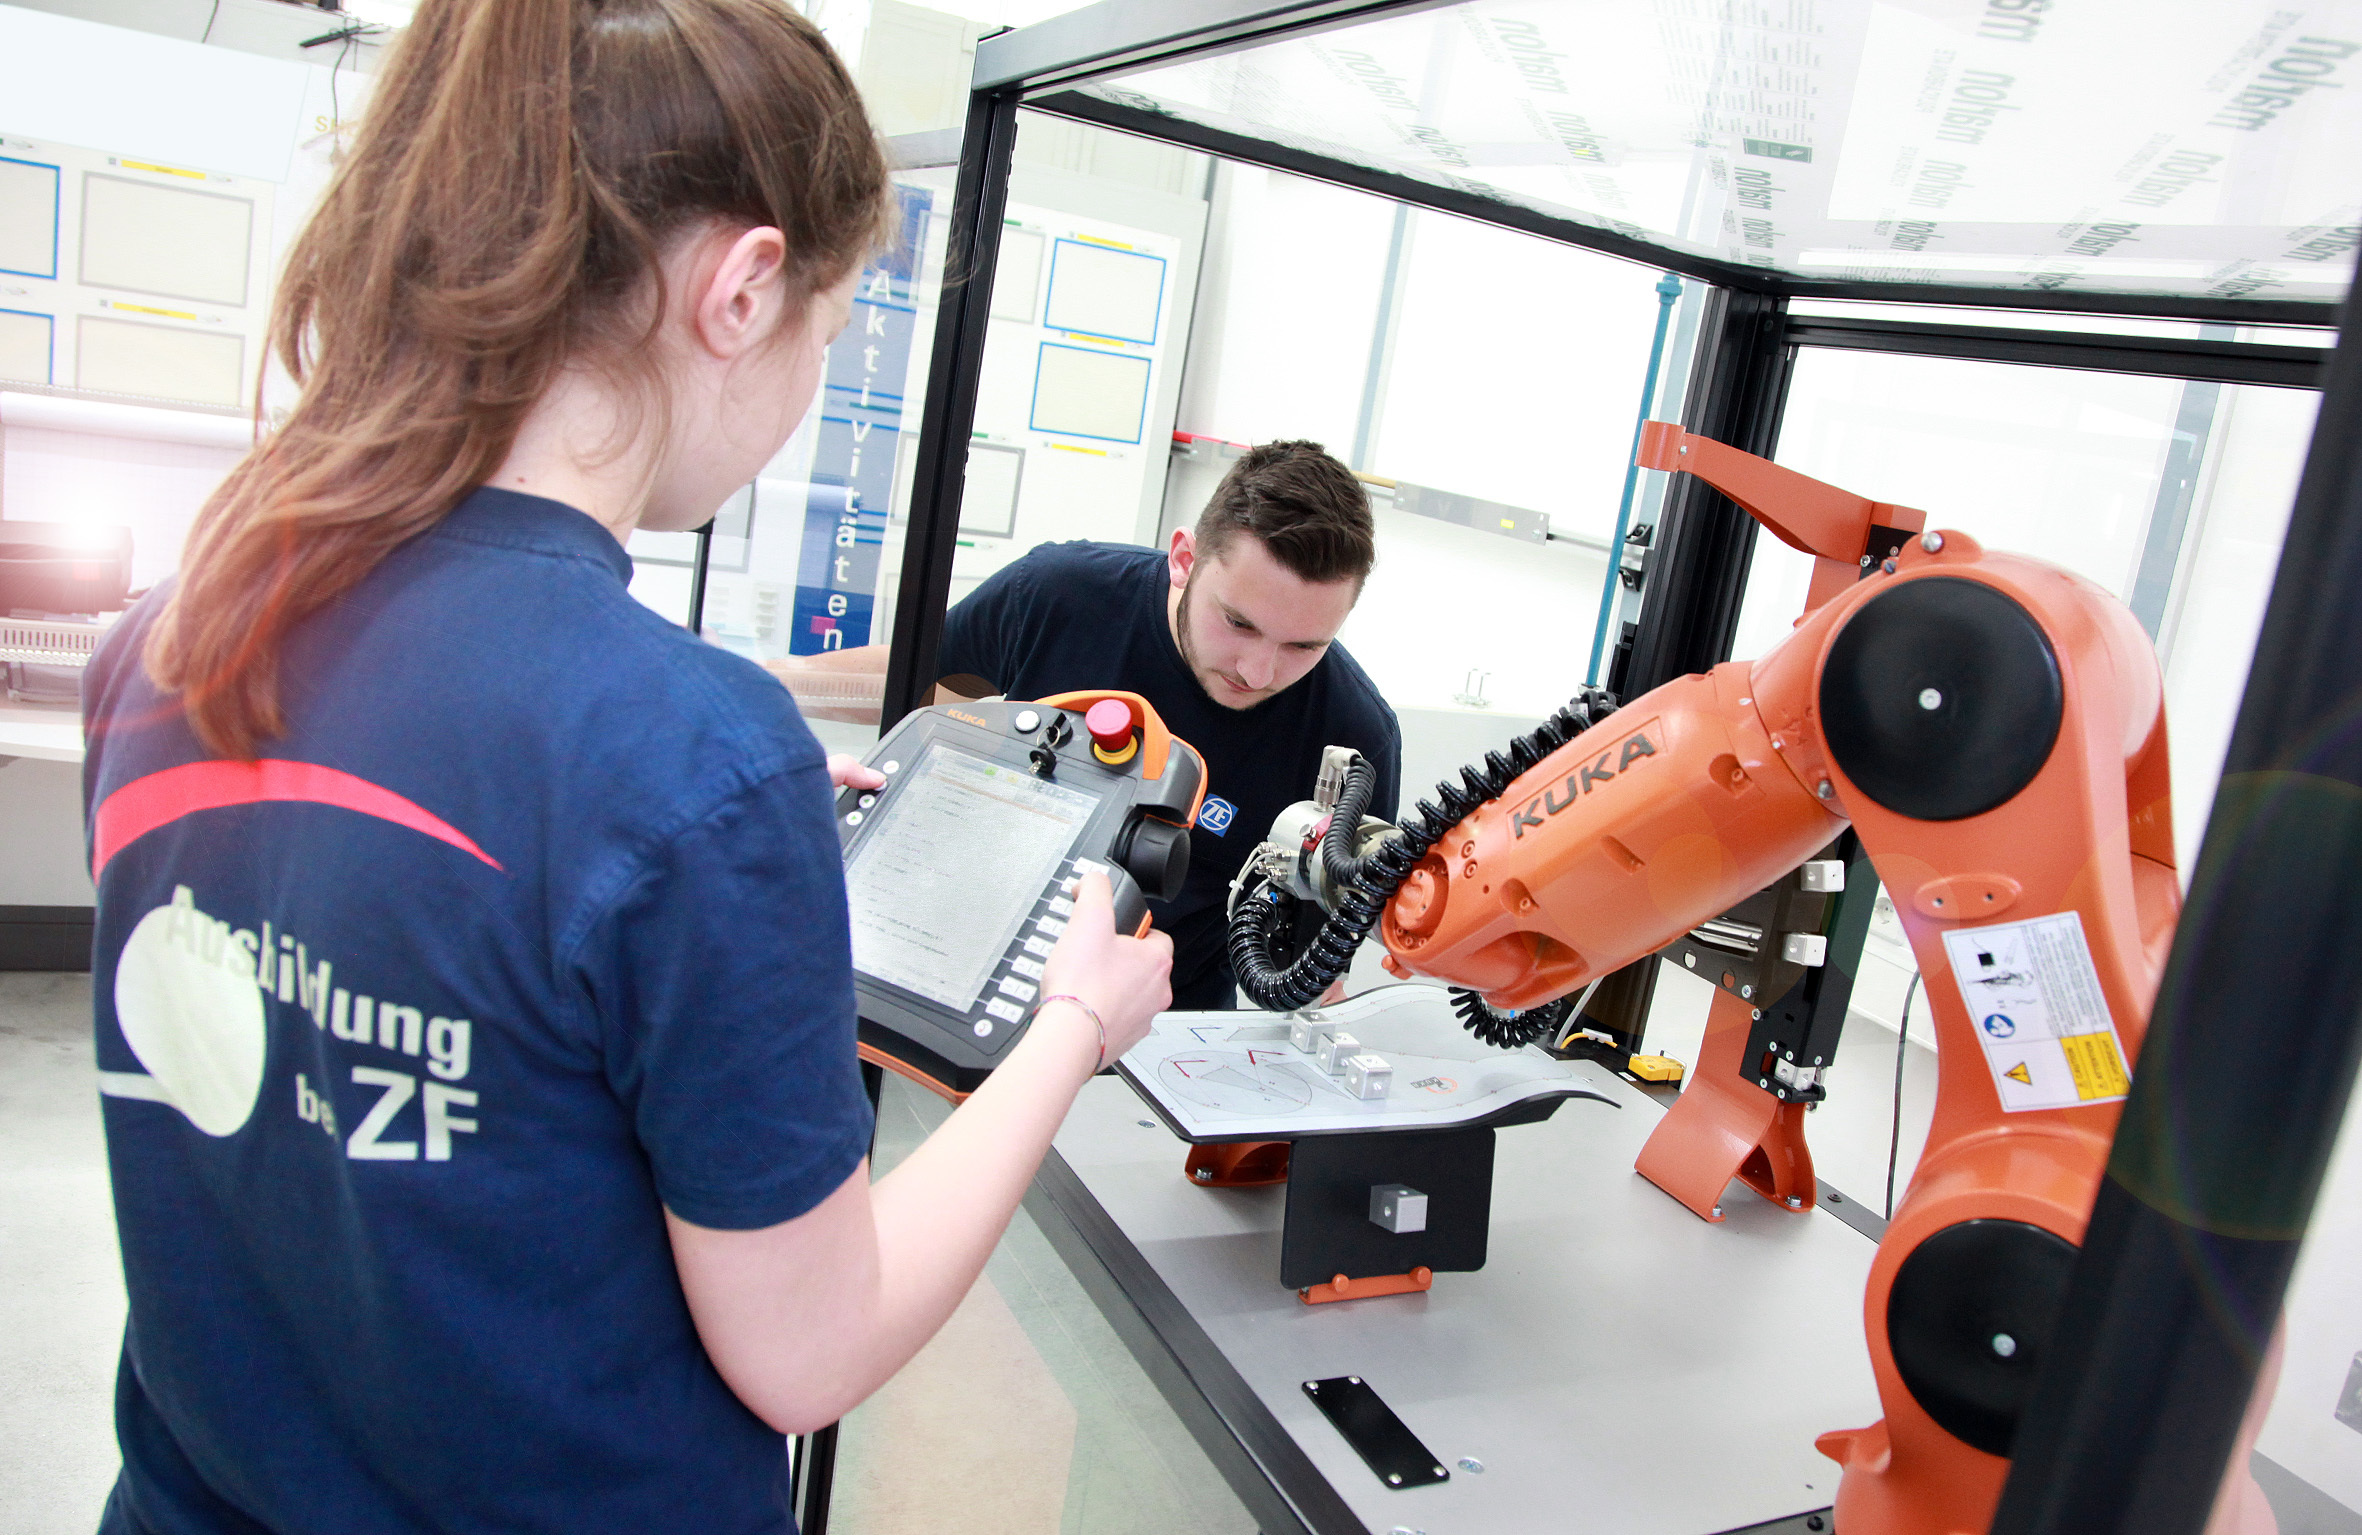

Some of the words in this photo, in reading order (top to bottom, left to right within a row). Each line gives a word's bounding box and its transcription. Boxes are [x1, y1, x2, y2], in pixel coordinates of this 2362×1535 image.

[822, 269, 892, 651] Aktivitäten
[946, 708, 987, 727] KUKA
[1200, 799, 1232, 830] ZF
[1513, 733, 1656, 839] KUKA
[165, 884, 472, 1081] Ausbildung
[346, 1065, 479, 1162] ZF
